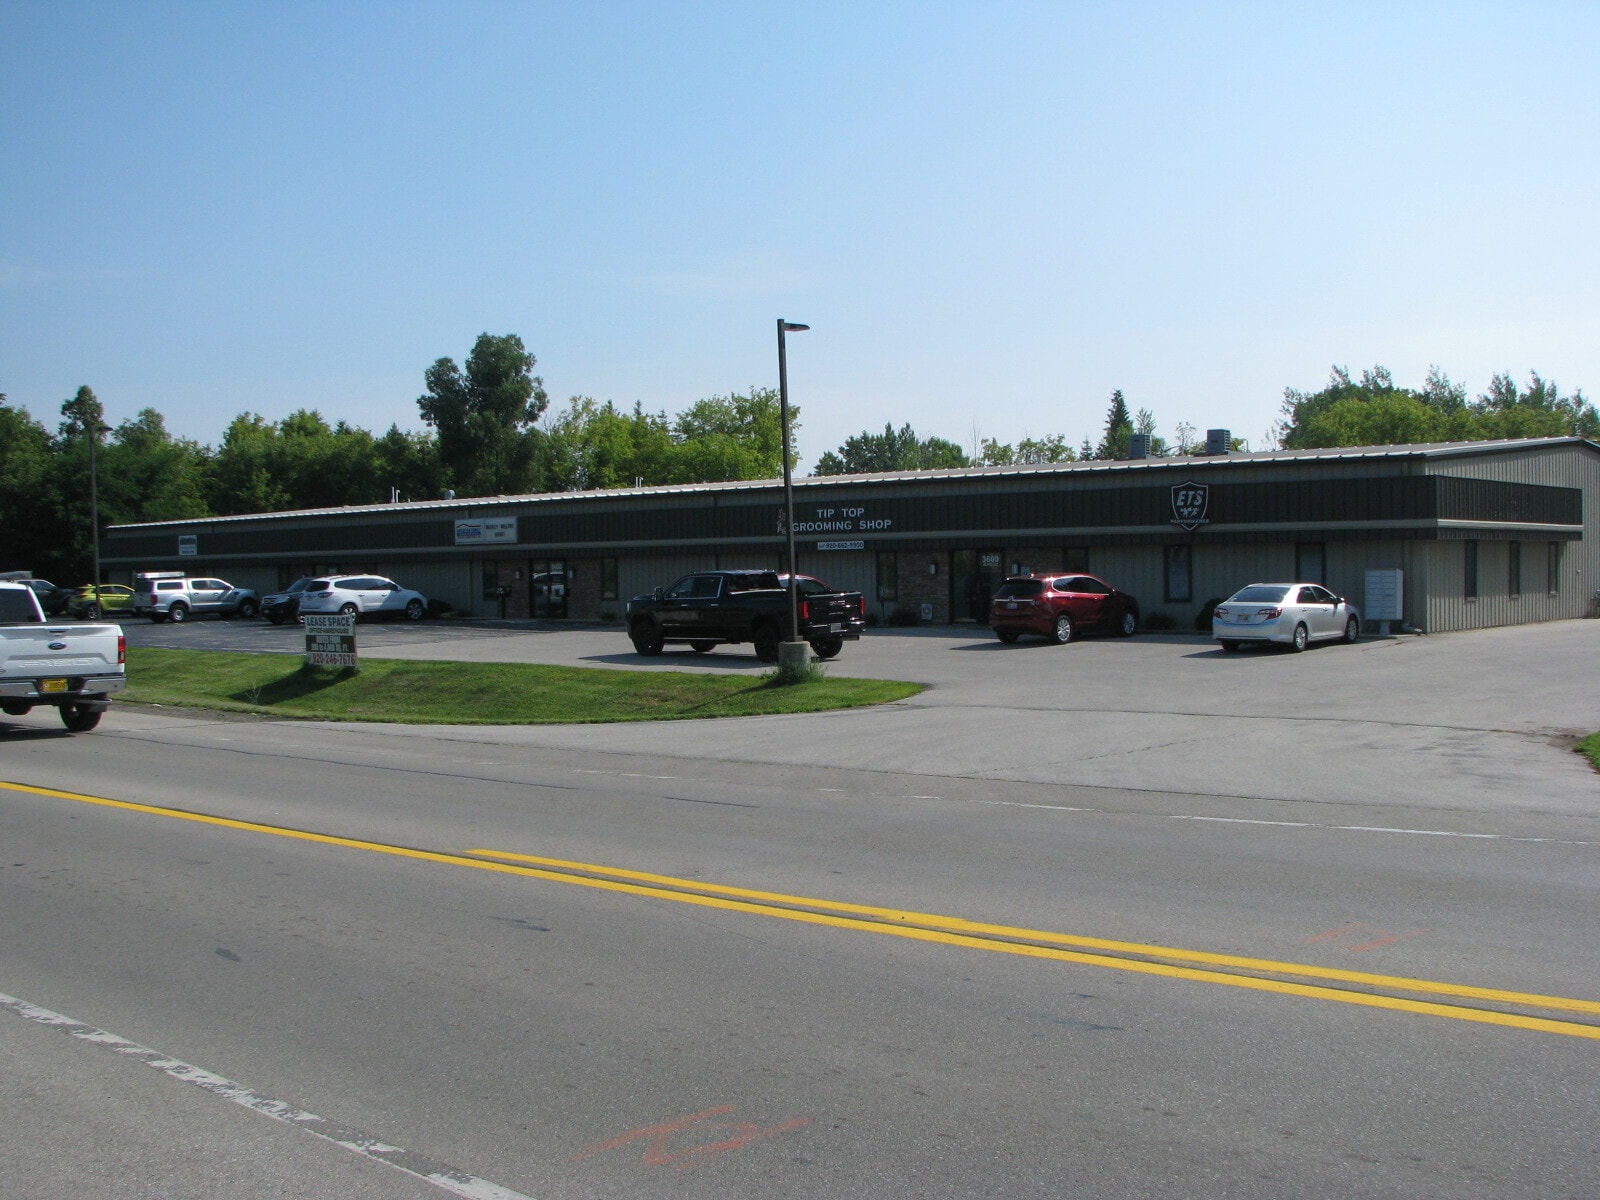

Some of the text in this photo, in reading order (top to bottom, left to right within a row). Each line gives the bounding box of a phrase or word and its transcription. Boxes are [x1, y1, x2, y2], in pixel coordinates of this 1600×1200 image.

[1176, 490, 1204, 506] ETS
[817, 507, 865, 519] TIP TOP
[792, 519, 892, 532] GROOMING SHOP
[307, 616, 350, 627] LEASE SPACE
